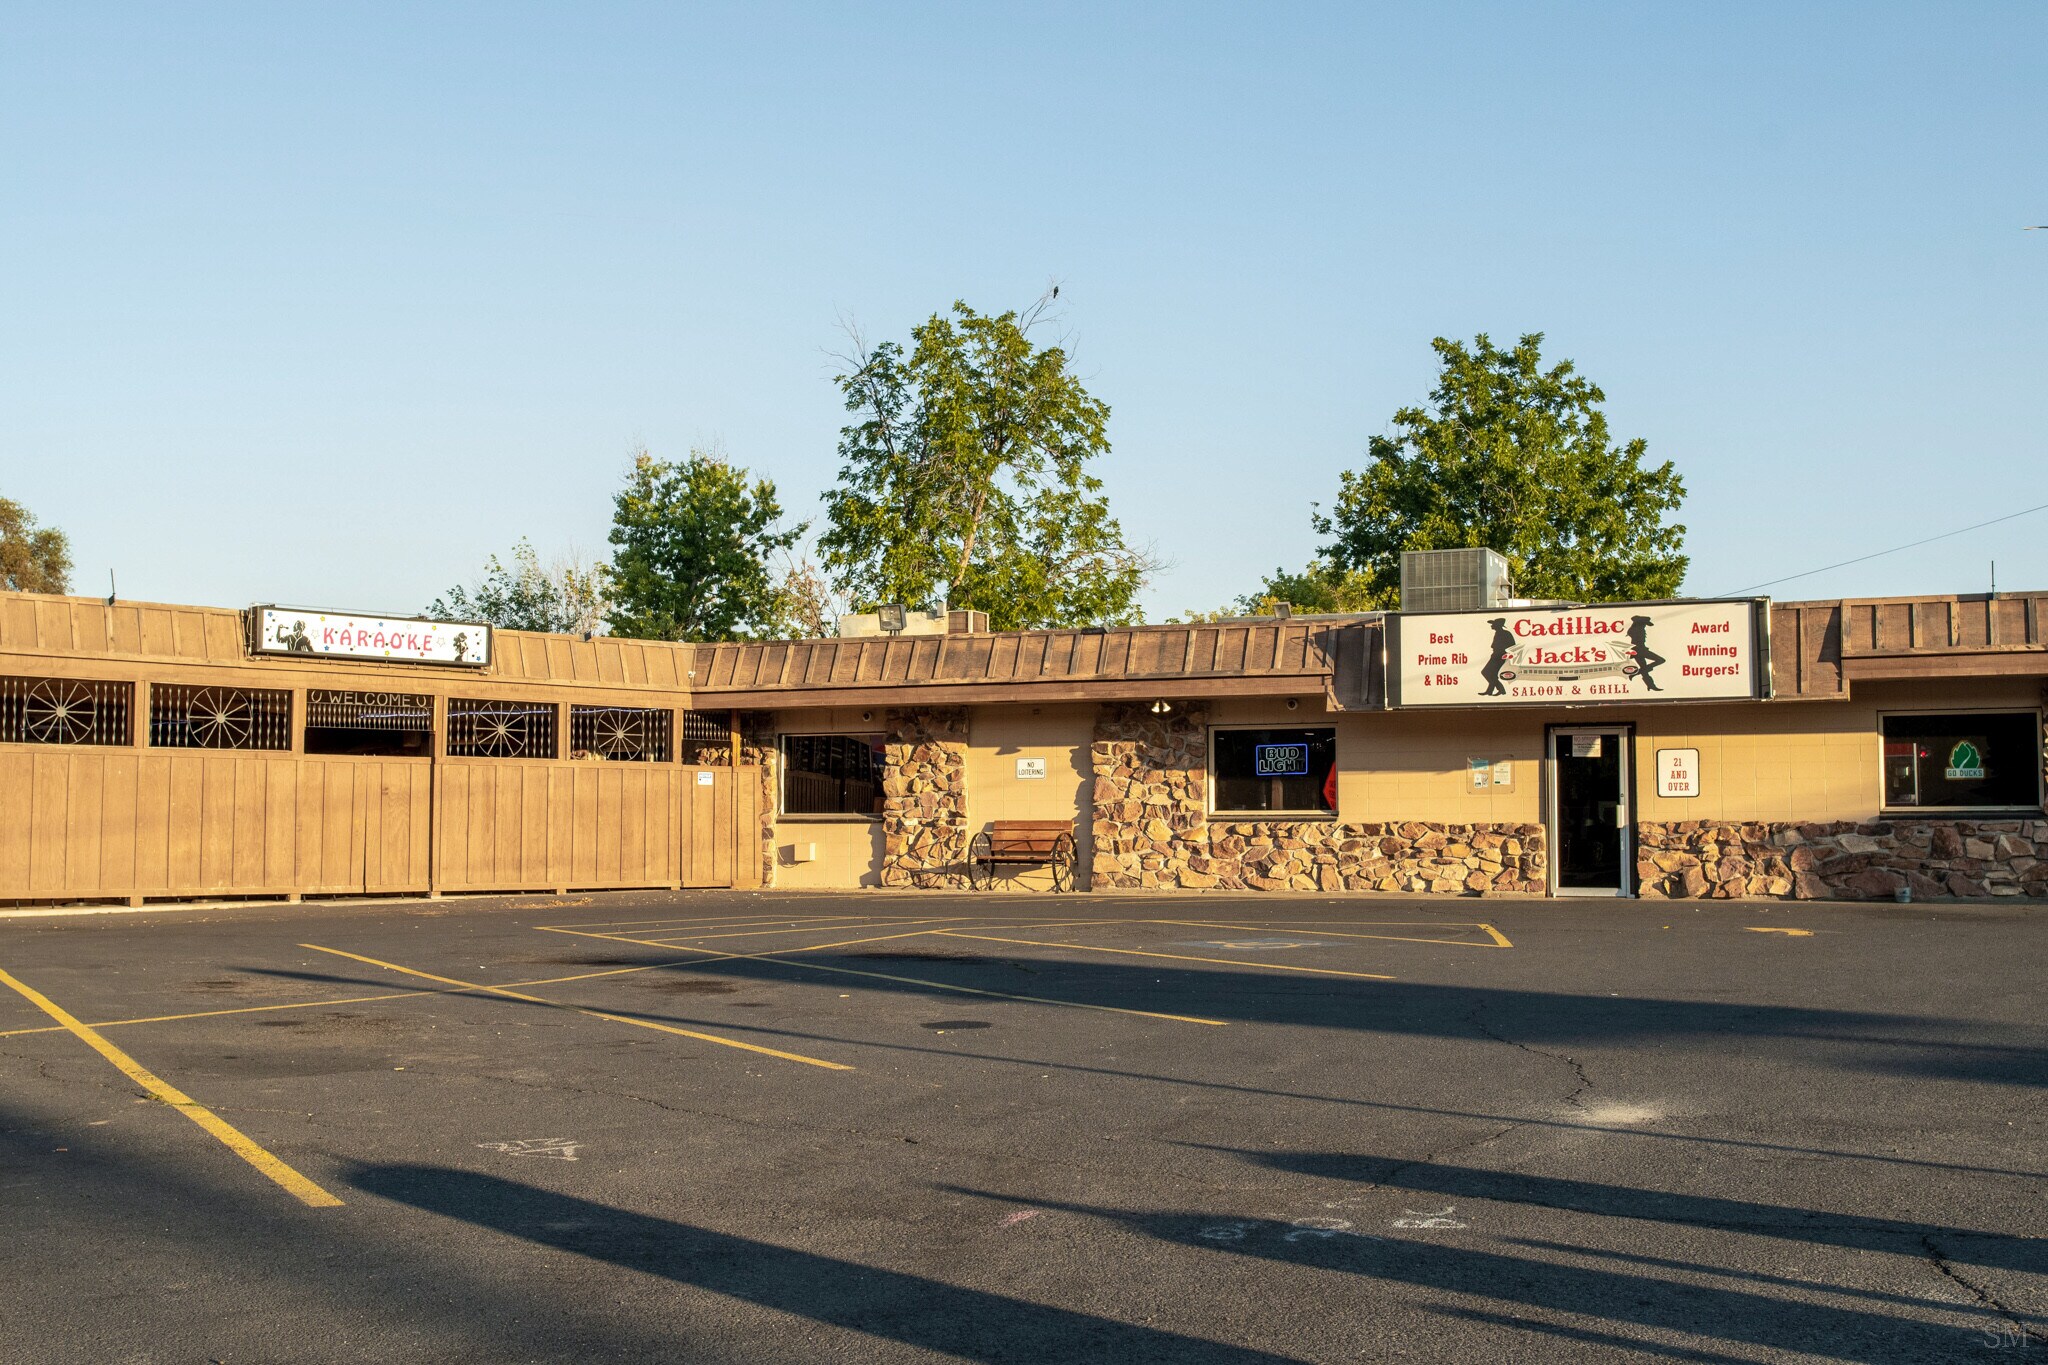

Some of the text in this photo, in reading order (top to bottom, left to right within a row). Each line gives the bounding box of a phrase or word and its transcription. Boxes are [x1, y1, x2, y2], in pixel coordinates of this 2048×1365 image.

[1513, 616, 1625, 637] Cadillac
[1691, 621, 1730, 634] Award
[323, 627, 433, 652] KARAOKE
[1430, 633, 1454, 644] Best
[1528, 646, 1607, 665] Jack's
[1687, 644, 1738, 658] Winning
[1418, 653, 1468, 666] Prime Rib
[1682, 663, 1740, 678] Burgers!
[1424, 674, 1459, 686] & Ribs
[1512, 683, 1630, 697] SALOON & GRILL
[328, 690, 412, 707] WELCOME
[1265, 747, 1300, 760] BUD
[1673, 757, 1682, 767] 21
[1018, 768, 1044, 776] LOITERING
[1670, 770, 1688, 779] AND
[1947, 769, 1983, 777] GO DUCKS
[1668, 782, 1690, 792] OVER
